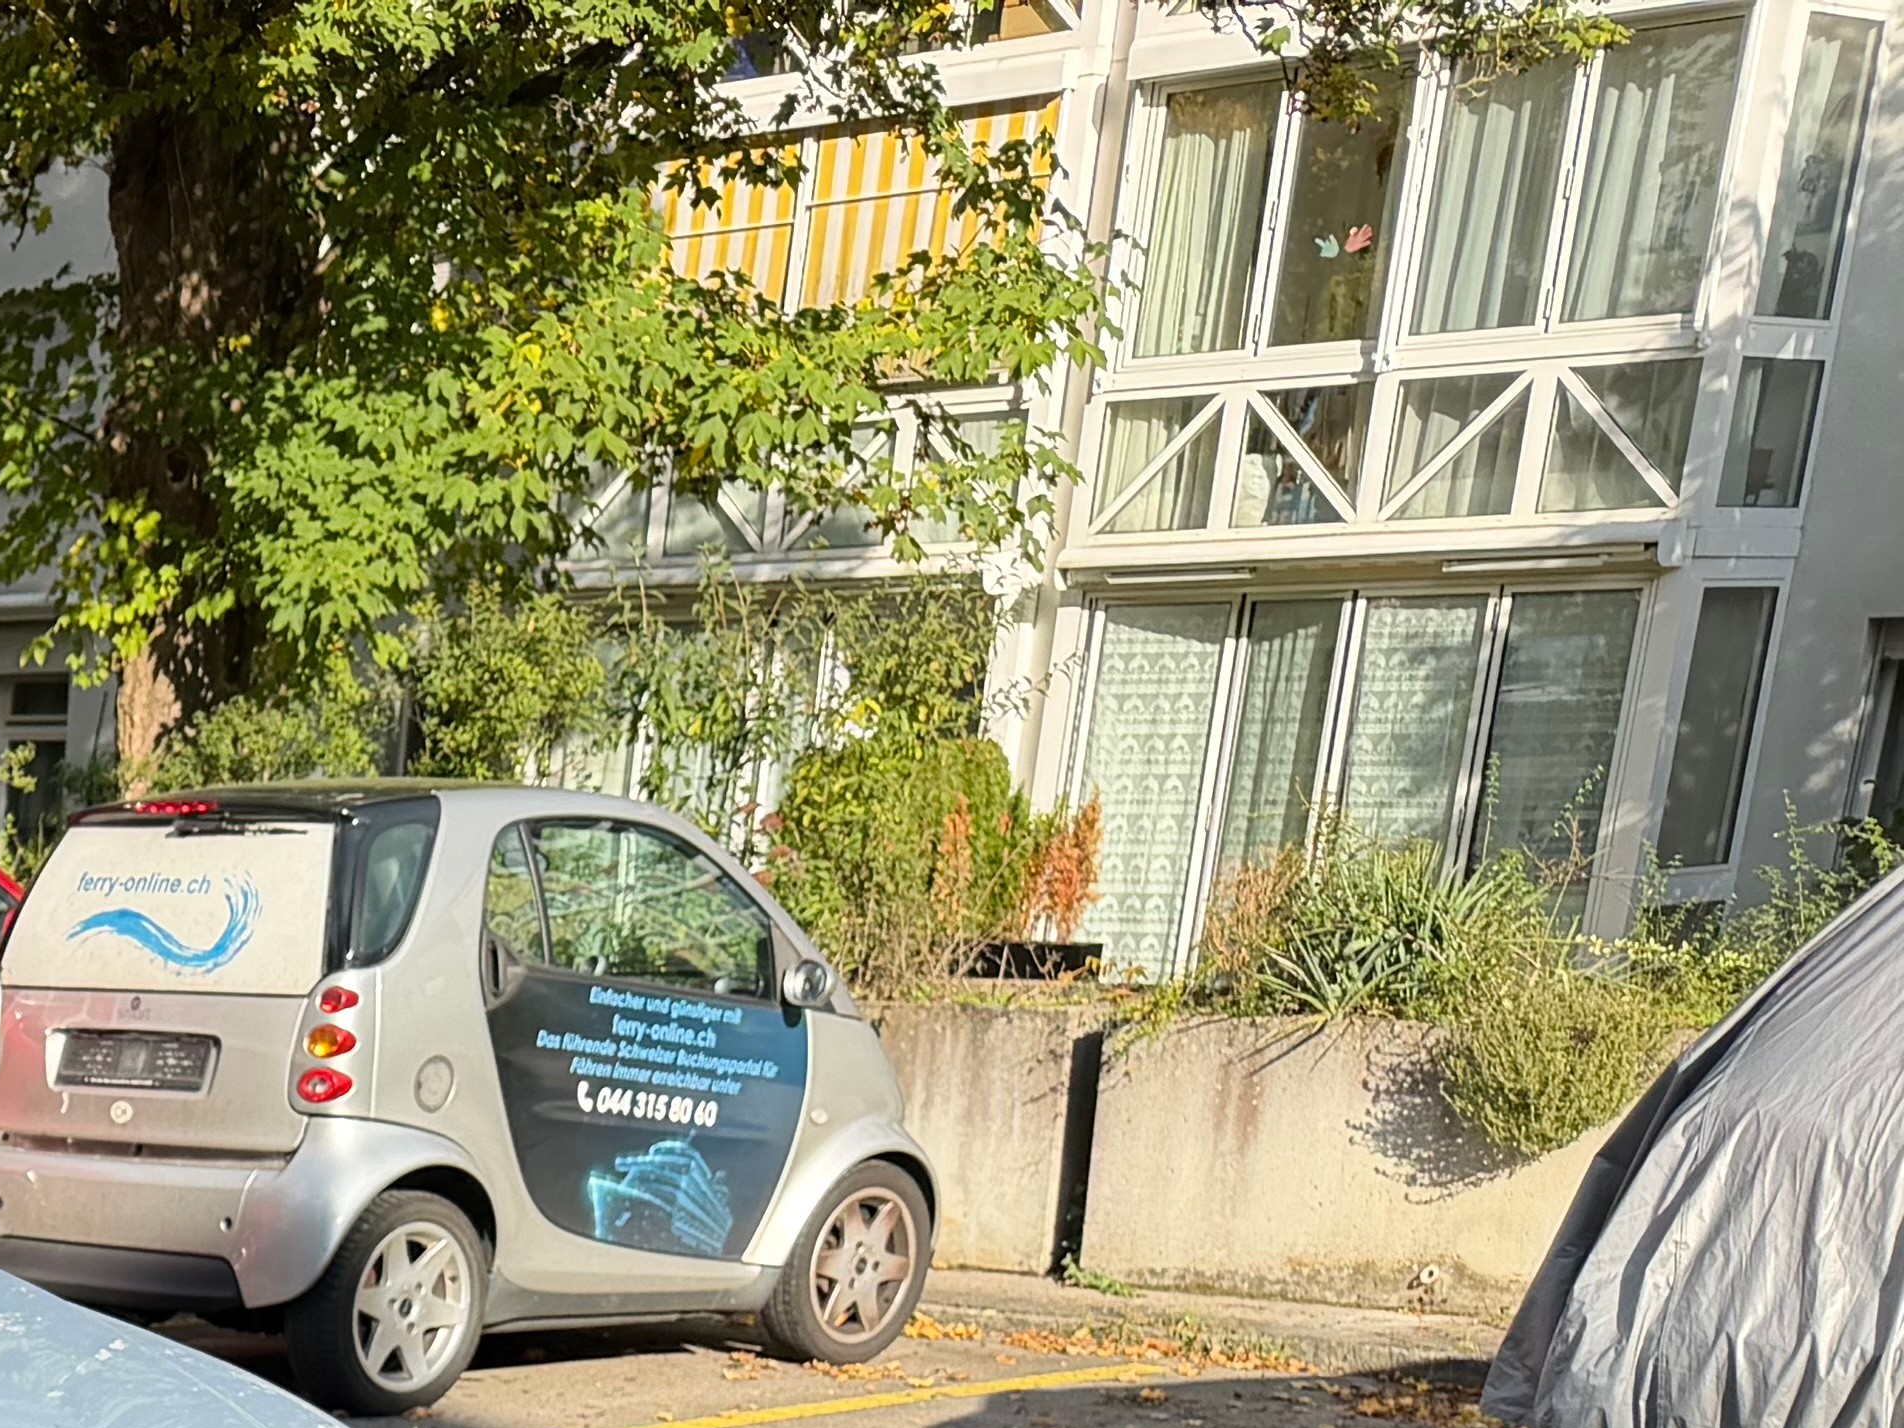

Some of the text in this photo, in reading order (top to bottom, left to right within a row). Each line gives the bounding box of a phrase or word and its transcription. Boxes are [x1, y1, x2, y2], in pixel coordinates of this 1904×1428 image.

[77, 871, 211, 897] ferry-online.ch
[589, 986, 645, 1010] Einfacher
[646, 997, 671, 1014] und
[670, 1000, 723, 1024] günstiger
[536, 1029, 562, 1049] Das
[562, 1032, 617, 1057] führende
[617, 1040, 676, 1065] Schweizer
[612, 1013, 717, 1049] ferry-online.ch
[597, 1086, 718, 1128] 044 315 80 60
